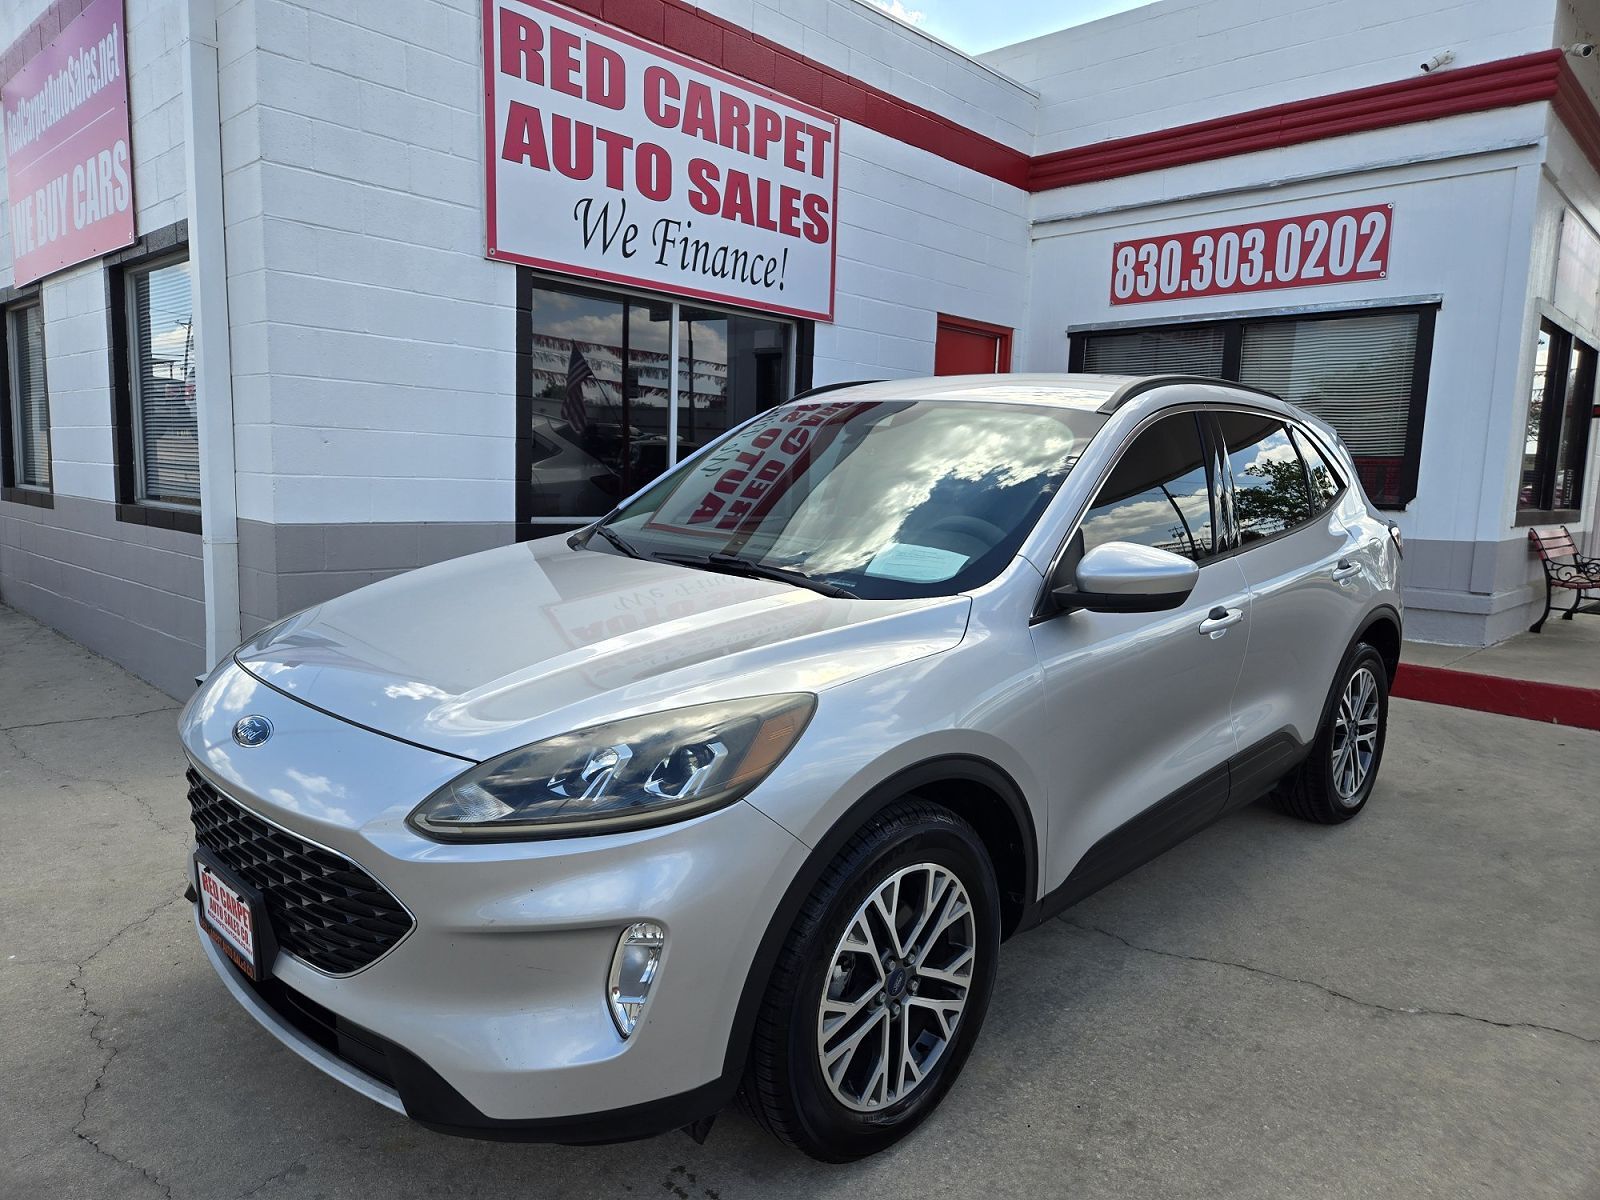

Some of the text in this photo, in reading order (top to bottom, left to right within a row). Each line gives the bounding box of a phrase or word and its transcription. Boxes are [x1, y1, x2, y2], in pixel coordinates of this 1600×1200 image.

[7, 22, 120, 156] RedCarpetAutoSales.net
[500, 6, 832, 179] RED CARPET
[12, 139, 129, 259] WE BUY CARS
[501, 99, 829, 245] AUTO SALES
[573, 197, 788, 291] We Finance!
[1114, 211, 1387, 299] 830.303.0202
[201, 871, 252, 930] RED CARPE
